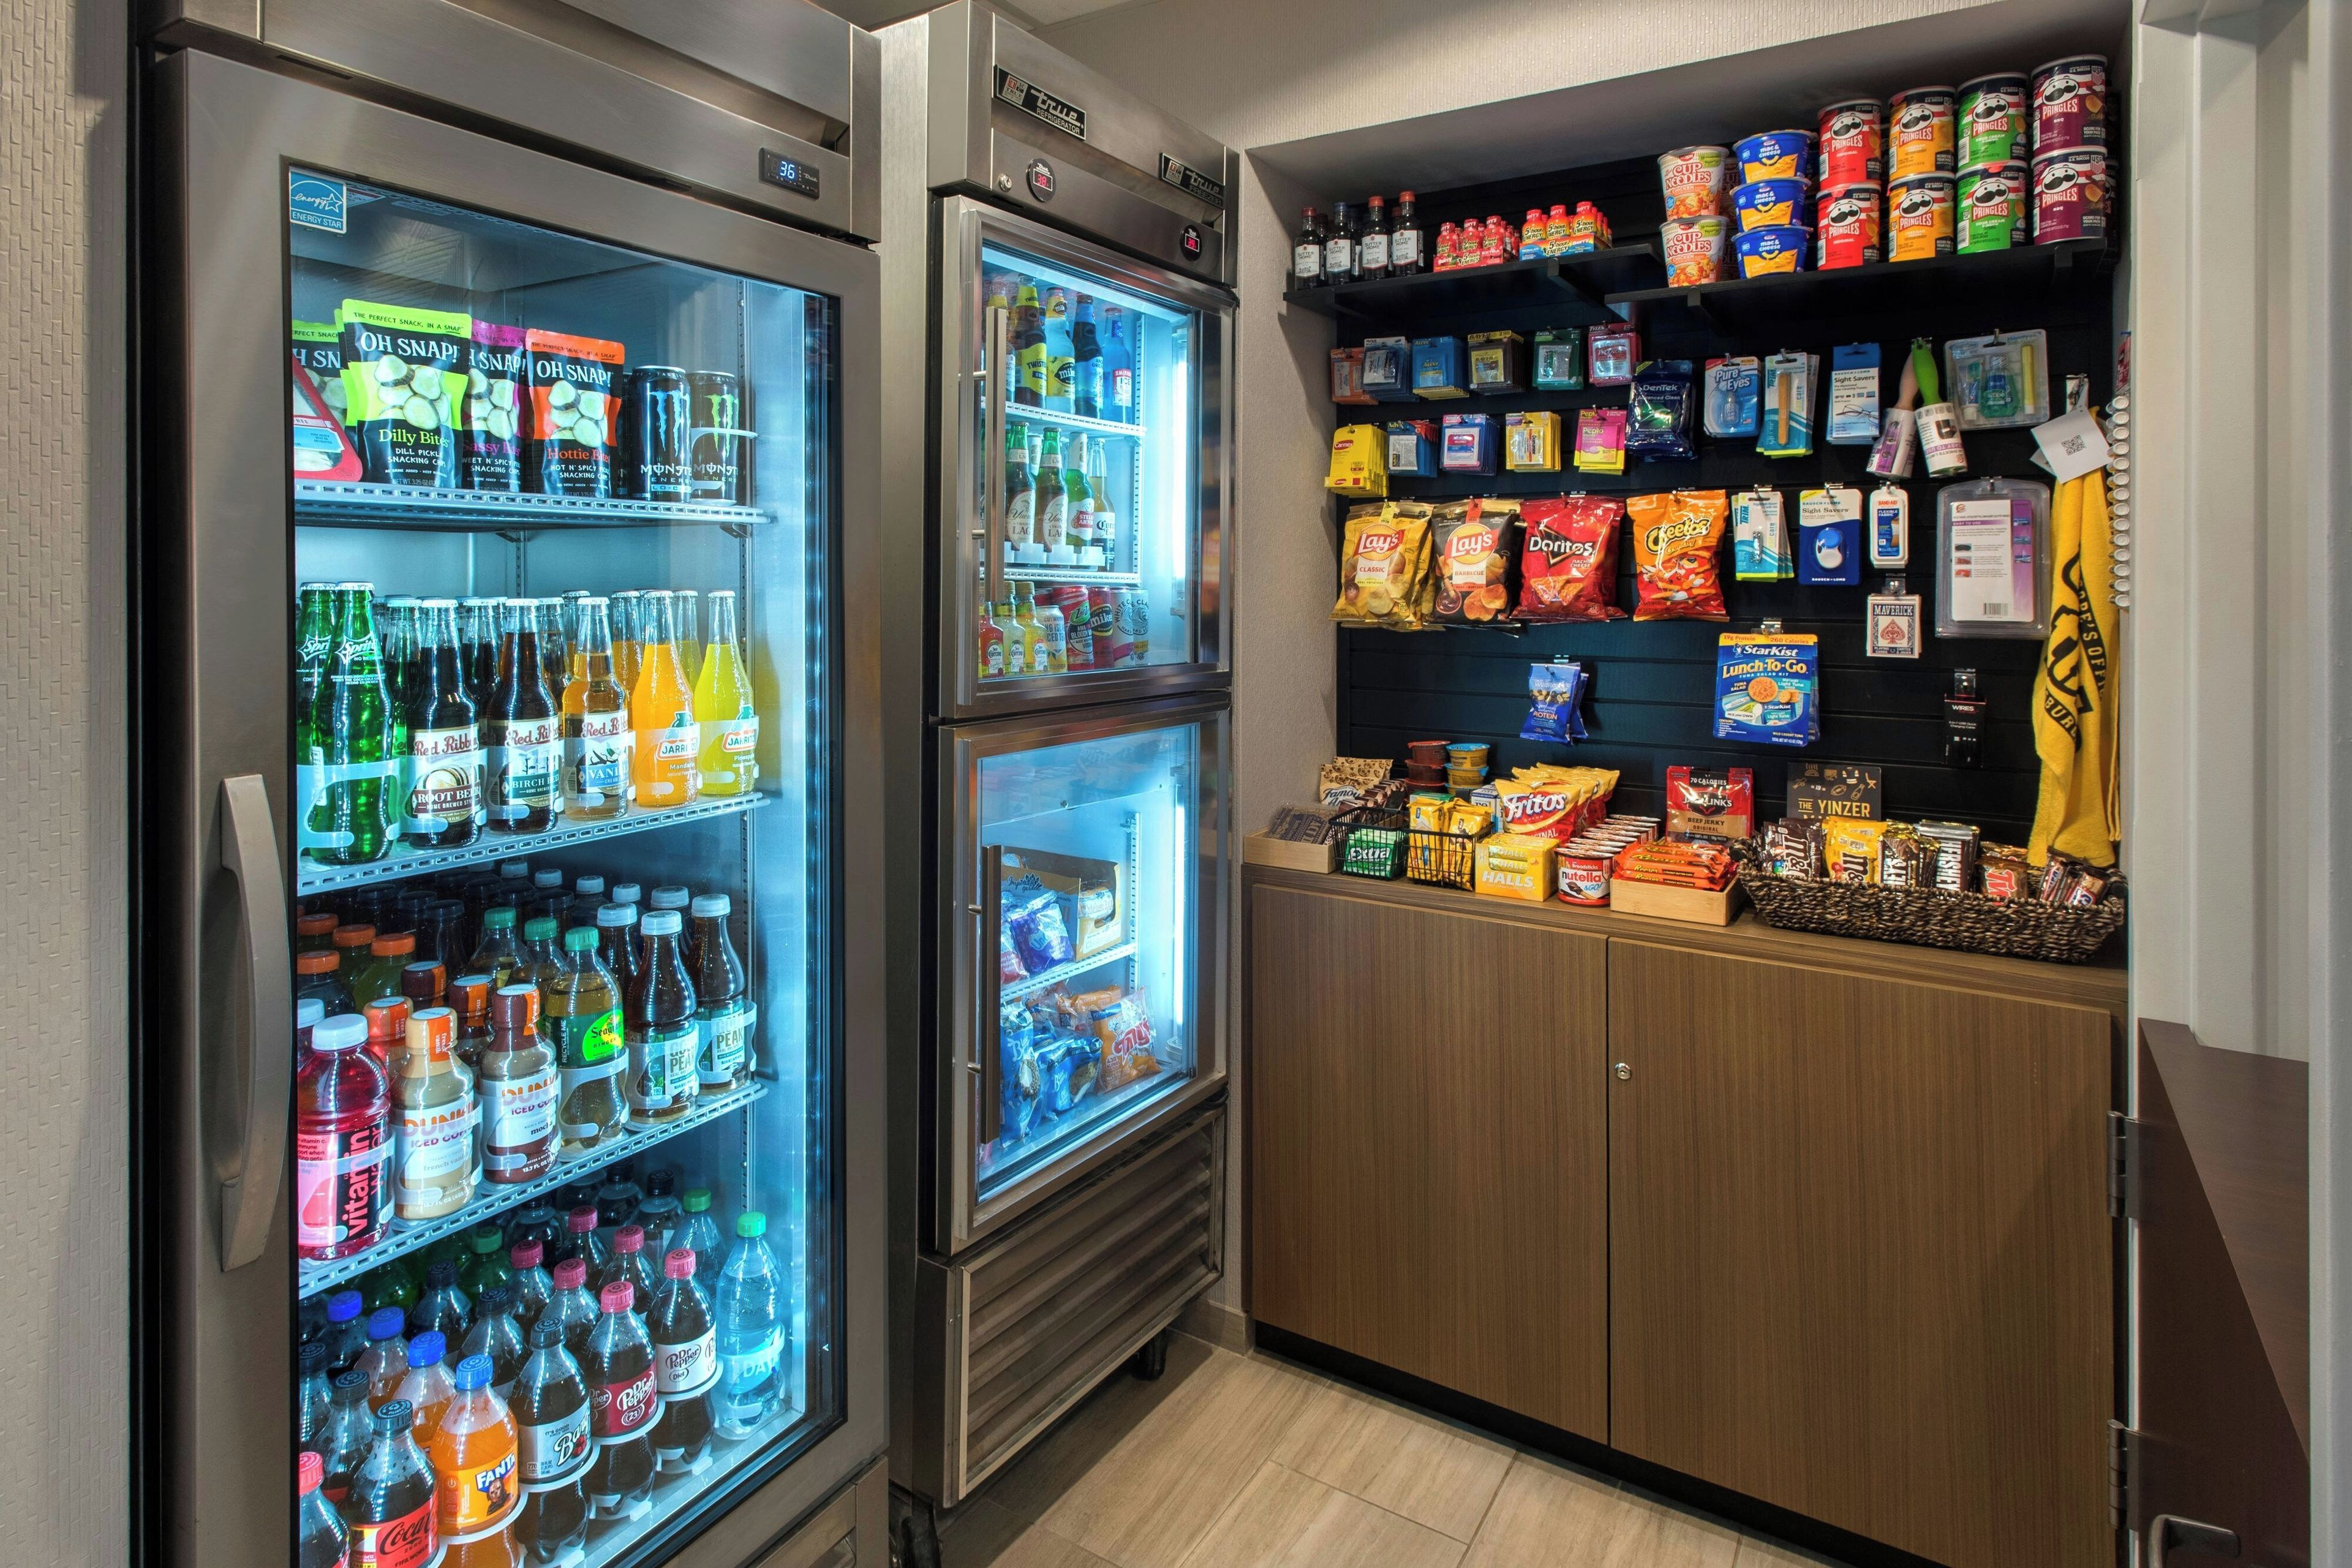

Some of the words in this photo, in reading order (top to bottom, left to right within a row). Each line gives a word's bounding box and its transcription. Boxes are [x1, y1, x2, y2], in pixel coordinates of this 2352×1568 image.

[2043, 100, 2078, 118] PRINGLES
[1036, 107, 1080, 134] REFRIGERATOR
[1973, 118, 2008, 135] PRINGLES
[1831, 135, 1863, 153] PRINGLES
[1899, 127, 1932, 145] PRINGLES
[780, 161, 794, 179] 36
[1673, 162, 1702, 175] CUP
[1038, 174, 1047, 187] 38
[1665, 172, 1711, 189] NOODLES
[295, 194, 326, 209] energy
[2043, 189, 2078, 206] PRINGLES
[292, 211, 321, 225] ENERGY
[323, 219, 342, 228] STAR
[1973, 203, 2008, 221] PRINGLES
[1829, 222, 1860, 238] PRINGLES
[1899, 214, 1932, 230] PRINGLES
[1525, 227, 1544, 236] 5-hour
[1673, 232, 1702, 243] CUP
[1547, 246, 1568, 255] ENERGY
[1549, 240, 1569, 249] 5-hour
[1667, 240, 1711, 258] NOODLES
[369, 314, 397, 323] PERFECT
[399, 318, 424, 328] SNACK,
[360, 332, 393, 353] OH
[398, 337, 458, 362] SNAP!
[480, 352, 527, 375] SNAP!
[537, 360, 564, 379] OH
[568, 365, 611, 387] SNAP!
[1716, 369, 1738, 384] Pure
[1727, 377, 1751, 392] Eyes
[379, 429, 417, 445] Dilly
[420, 431, 449, 448] Bites
[547, 448, 590, 460] Hottie
[1740, 505, 1749, 524] TRIM
[1359, 532, 1400, 554] Lay's
[1451, 531, 1493, 557] Lay's
[1647, 518, 1711, 554] Cheetos
[1529, 537, 1594, 556] Doritos
[1874, 605, 1913, 616] MAVERICK
[1744, 645, 1799, 657] StarKist
[1722, 658, 1807, 679] Lunch-To-Go
[507, 730, 533, 745] Red
[581, 722, 607, 737] Red
[413, 741, 440, 756] Red
[513, 778, 545, 788] BIRCH
[418, 791, 453, 804] ROOT
[1504, 793, 1566, 822] Fritos
[1798, 801, 1812, 810] THE
[1818, 799, 1870, 818] YINZER
[1348, 848, 1390, 862] Extra
[1482, 872, 1534, 888] HALLS
[1562, 871, 1602, 883] nutella
[561, 1020, 566, 1031] ME
[716, 1028, 743, 1049] PEAK
[511, 1105, 535, 1115] ICED
[424, 1160, 449, 1171] french
[342, 1129, 369, 1237] vitamin
[669, 1348, 700, 1370] Pepper
[678, 1347, 692, 1358] Dr
[673, 1372, 686, 1381] Diet
[622, 1376, 652, 1411] Pepper
[633, 1377, 647, 1395] Dr
[629, 1411, 638, 1421] 23
[404, 1540, 423, 1553] ZERO
[410, 1544, 429, 1560] WORLD
